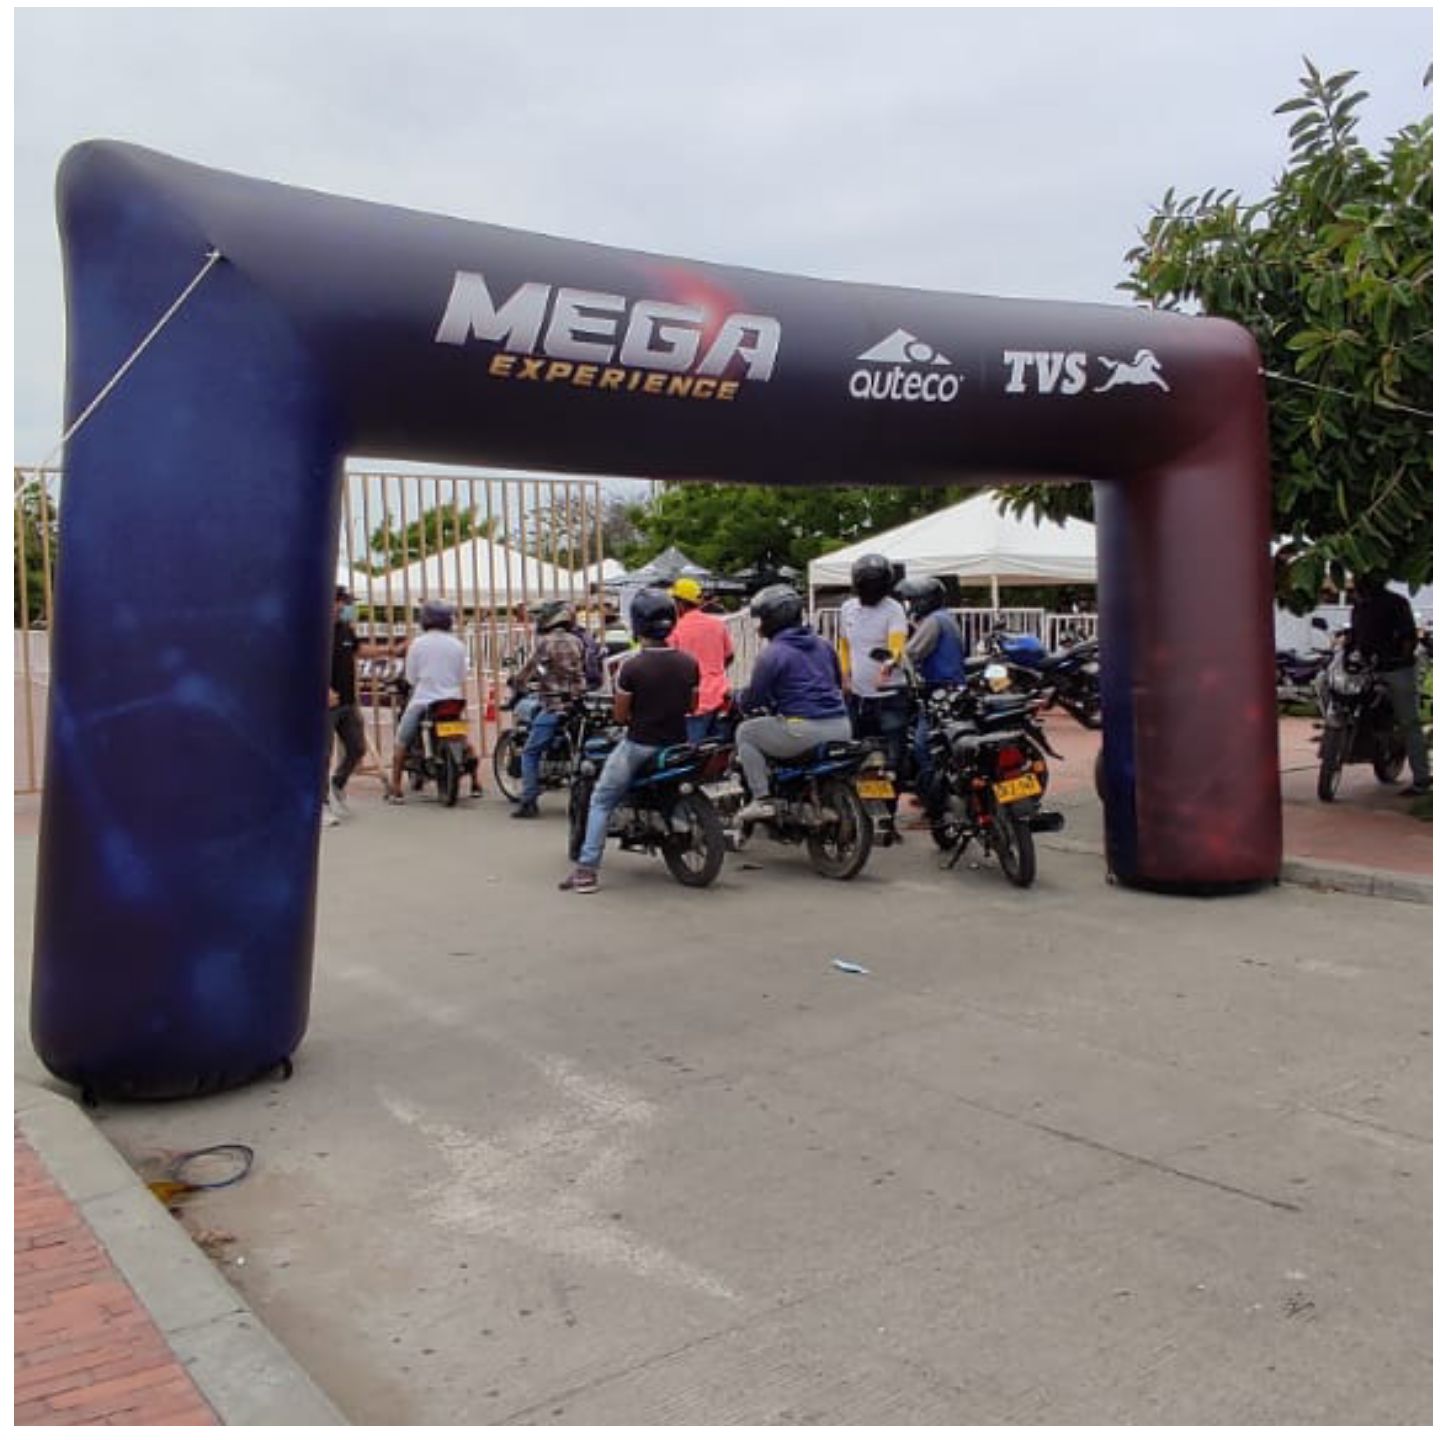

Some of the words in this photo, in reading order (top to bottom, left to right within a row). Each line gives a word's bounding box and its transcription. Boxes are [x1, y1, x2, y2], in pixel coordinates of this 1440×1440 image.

[435, 270, 782, 383] MEGA
[488, 354, 740, 401] EXPERIENCE
[849, 366, 959, 402] auteco
[1004, 349, 1087, 395] TVS
